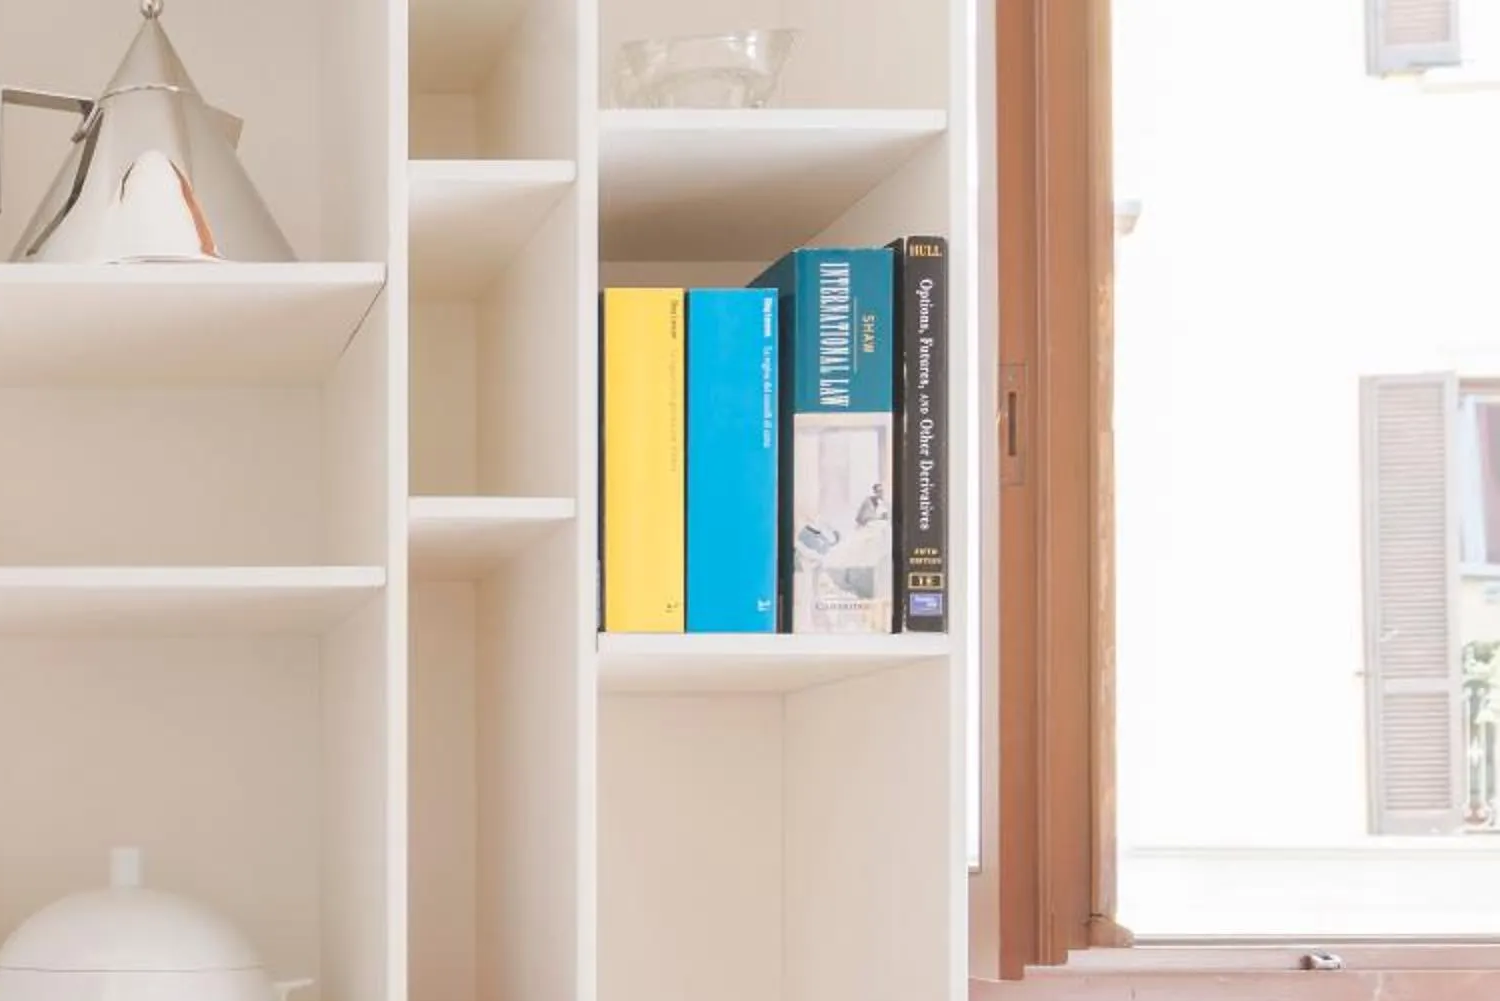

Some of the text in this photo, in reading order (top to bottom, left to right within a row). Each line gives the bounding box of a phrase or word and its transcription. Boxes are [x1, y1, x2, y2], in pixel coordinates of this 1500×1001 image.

[861, 313, 877, 353] SHAW
[915, 278, 934, 335] Options,
[819, 261, 851, 409] INTERNATIONAL LAW
[917, 337, 934, 389] Futures,
[919, 418, 935, 457] Other
[919, 459, 935, 531] Derivatives
